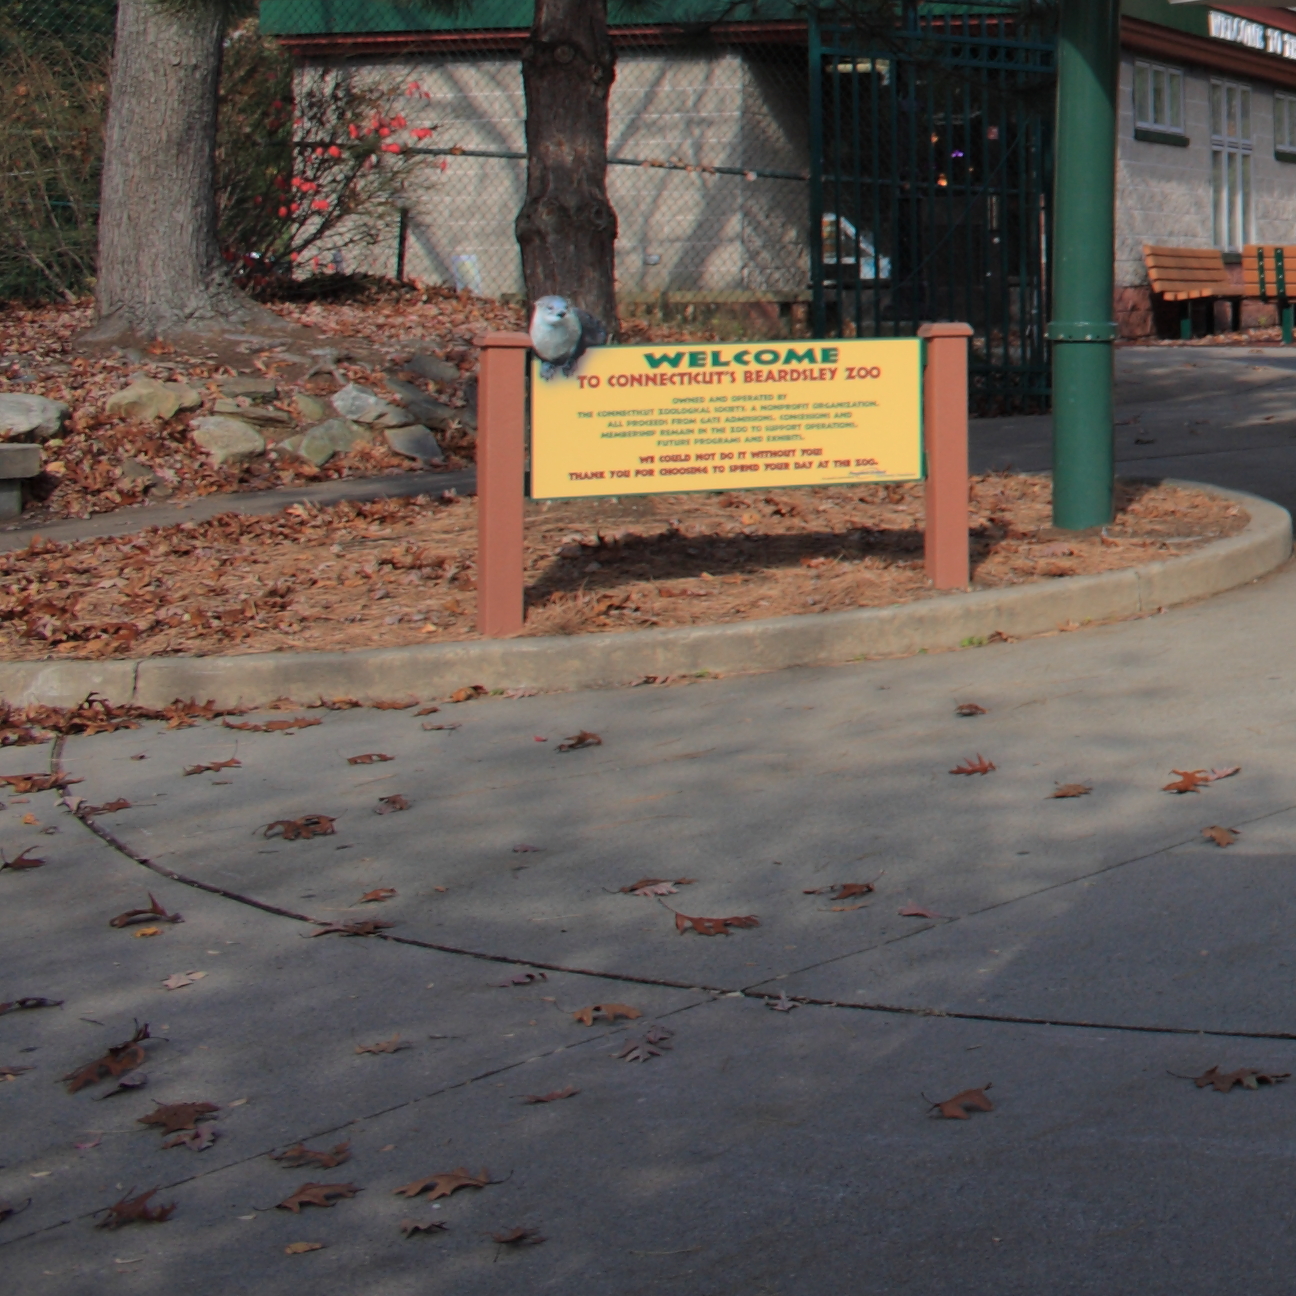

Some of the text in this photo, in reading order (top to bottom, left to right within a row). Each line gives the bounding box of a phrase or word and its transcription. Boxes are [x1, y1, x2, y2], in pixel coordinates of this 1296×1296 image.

[644, 347, 839, 369] WELCOME
[578, 367, 880, 389] TO CONNECTICUT'S BEARDSLEY ZOO
[731, 394, 774, 402] OPERATED
[597, 409, 654, 417] CONNECTICUT
[760, 403, 808, 411] NONPROFIT
[694, 437, 740, 445] PROGRAMS
[659, 454, 690, 463] COULD
[695, 453, 717, 461] NOT
[720, 452, 735, 460] DO
[737, 451, 747, 459] IT
[750, 449, 796, 459] WITHOUT
[569, 471, 605, 481] THANK
[609, 469, 631, 478] YOU
[635, 468, 655, 477] FOR
[659, 465, 708, 476] CHOOSING
[712, 465, 725, 474] TO
[729, 464, 760, 473] SPEND
[764, 462, 789, 471] YOUR
[794, 461, 813, 470] DAY
[817, 460, 830, 469] AT
[833, 459, 851, 468] THE
